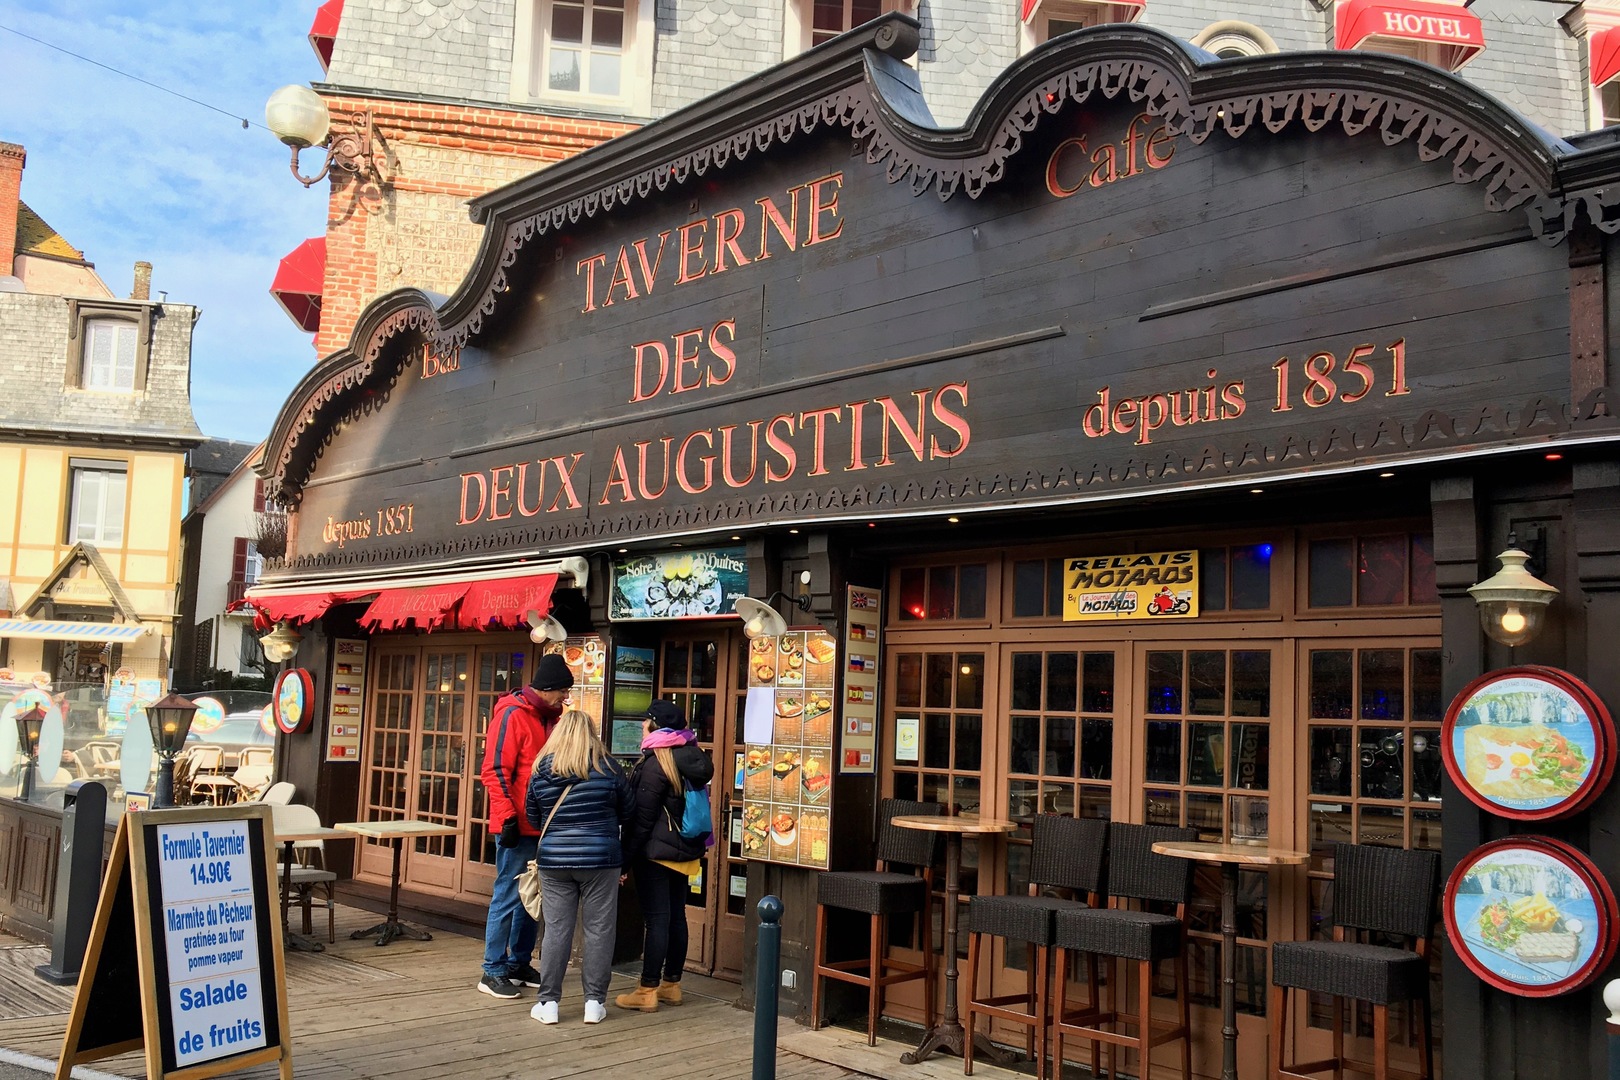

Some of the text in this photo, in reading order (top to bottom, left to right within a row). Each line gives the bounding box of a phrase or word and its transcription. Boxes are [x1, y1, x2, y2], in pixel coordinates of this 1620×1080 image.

[1383, 11, 1470, 39] HOTEL
[576, 171, 846, 314] TAVERNE
[628, 318, 738, 404] DES
[1081, 336, 1412, 446] depuis 1851
[456, 380, 971, 526] DEUX AUGUSTINS
[322, 503, 415, 549] depuis 1851
[625, 562, 653, 580] Notre
[1068, 552, 1193, 571] RELAIS
[1070, 565, 1194, 590] MOTARDS
[482, 588, 520, 615] Depuis
[1067, 593, 1077, 604] By
[1082, 599, 1137, 612] MOTARDS
[1090, 593, 1112, 602] Journal
[1125, 592, 1136, 600] des
[1497, 795, 1549, 806] Depuis 1851
[162, 829, 245, 861] Formule Tavernier
[190, 860, 232, 886] 14.90€
[167, 901, 253, 932] Marmite du Pêcheur
[183, 927, 245, 954] gratinée au four
[188, 949, 244, 972] pomme vapeur
[1500, 968, 1529, 981] Depuis
[179, 979, 248, 1012] Salade
[178, 1017, 262, 1055] de fruits
